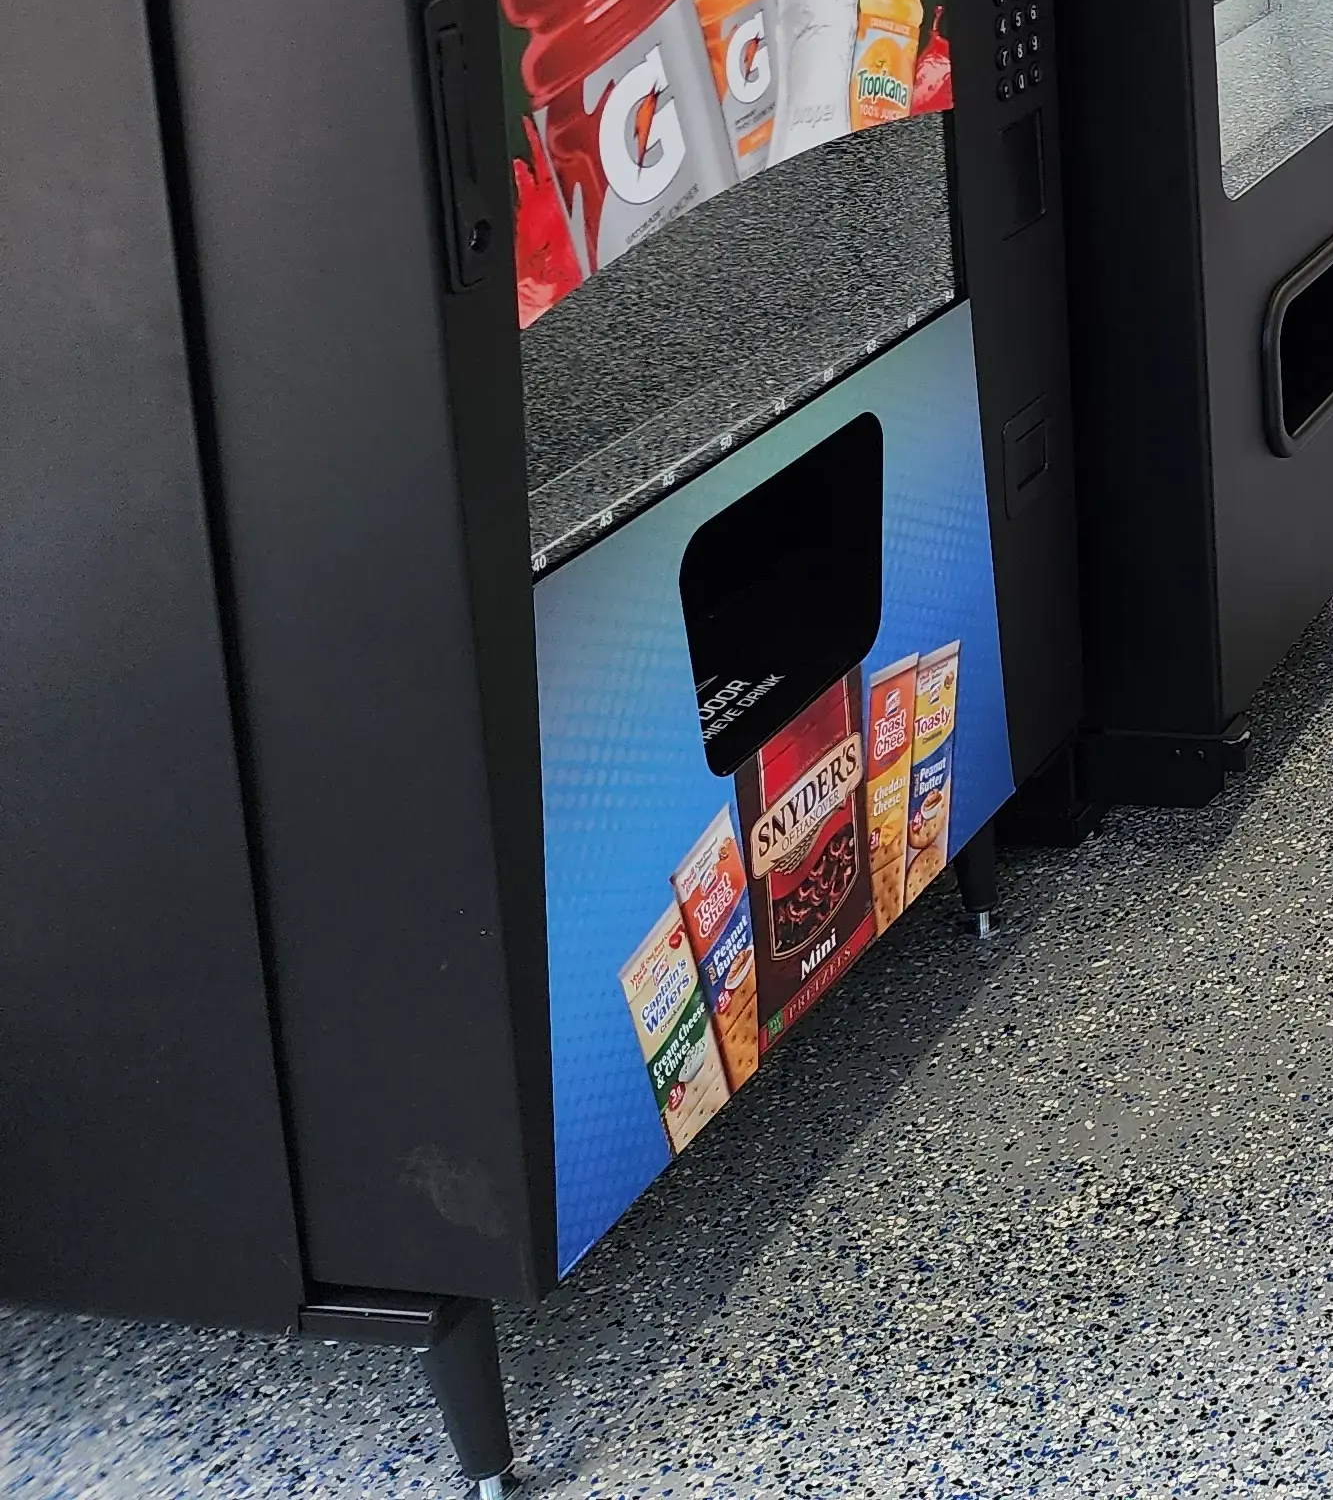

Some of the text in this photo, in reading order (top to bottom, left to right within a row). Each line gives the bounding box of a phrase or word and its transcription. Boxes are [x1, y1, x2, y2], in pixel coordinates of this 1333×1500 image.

[725, 11, 771, 103] G
[857, 69, 908, 107] Tropicana
[599, 45, 686, 204] G
[736, 674, 786, 707] DRINK
[874, 732, 905, 758] Chee
[875, 709, 906, 736] Toast
[915, 705, 951, 737] Toasty
[874, 775, 907, 802] Cheddar
[919, 773, 944, 795] Butter
[920, 757, 946, 780] Peanut
[757, 742, 858, 856] SNYDER'S
[781, 789, 840, 852] OF HANOVER
[873, 793, 901, 817] Cheese
[694, 872, 730, 921] Toast
[700, 889, 734, 938] Chee
[713, 914, 748, 963] Peanut
[716, 931, 748, 980] Butter
[801, 928, 837, 981] Mini
[641, 958, 687, 1022] Captain's
[645, 972, 691, 1037] Wafers
[653, 1001, 706, 1078] Cream Cheese
[656, 1039, 692, 1090] & Chives
